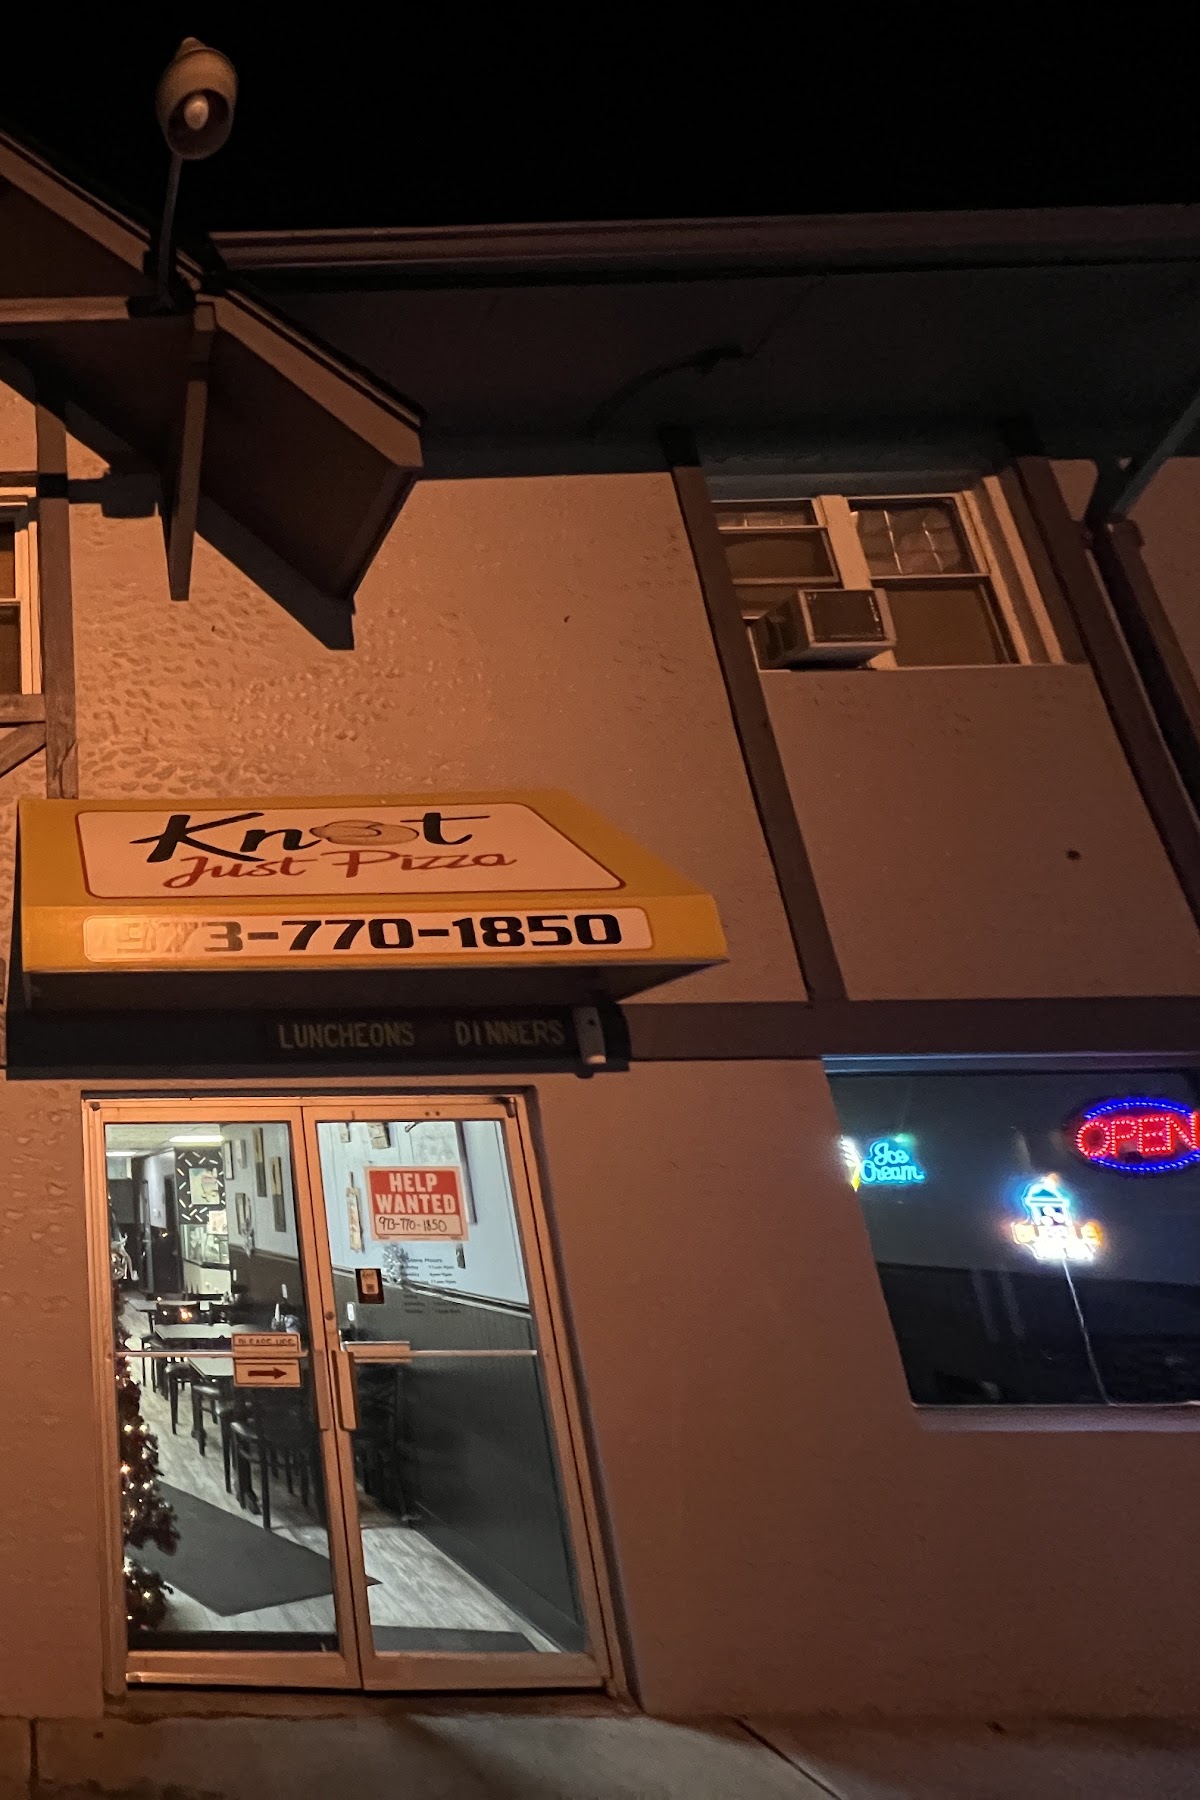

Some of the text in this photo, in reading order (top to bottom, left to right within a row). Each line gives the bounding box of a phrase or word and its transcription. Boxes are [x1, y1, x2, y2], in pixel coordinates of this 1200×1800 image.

[163, 849, 517, 889] Just Pizza
[279, 1020, 565, 1048] LUNCHEONS DINNERS
[1076, 1113, 1200, 1157] OPEN
[860, 1160, 925, 1182] Cream
[388, 1173, 438, 1192] HELP
[375, 1194, 456, 1214] WANTED
[378, 1216, 447, 1232] 973-770-1850
